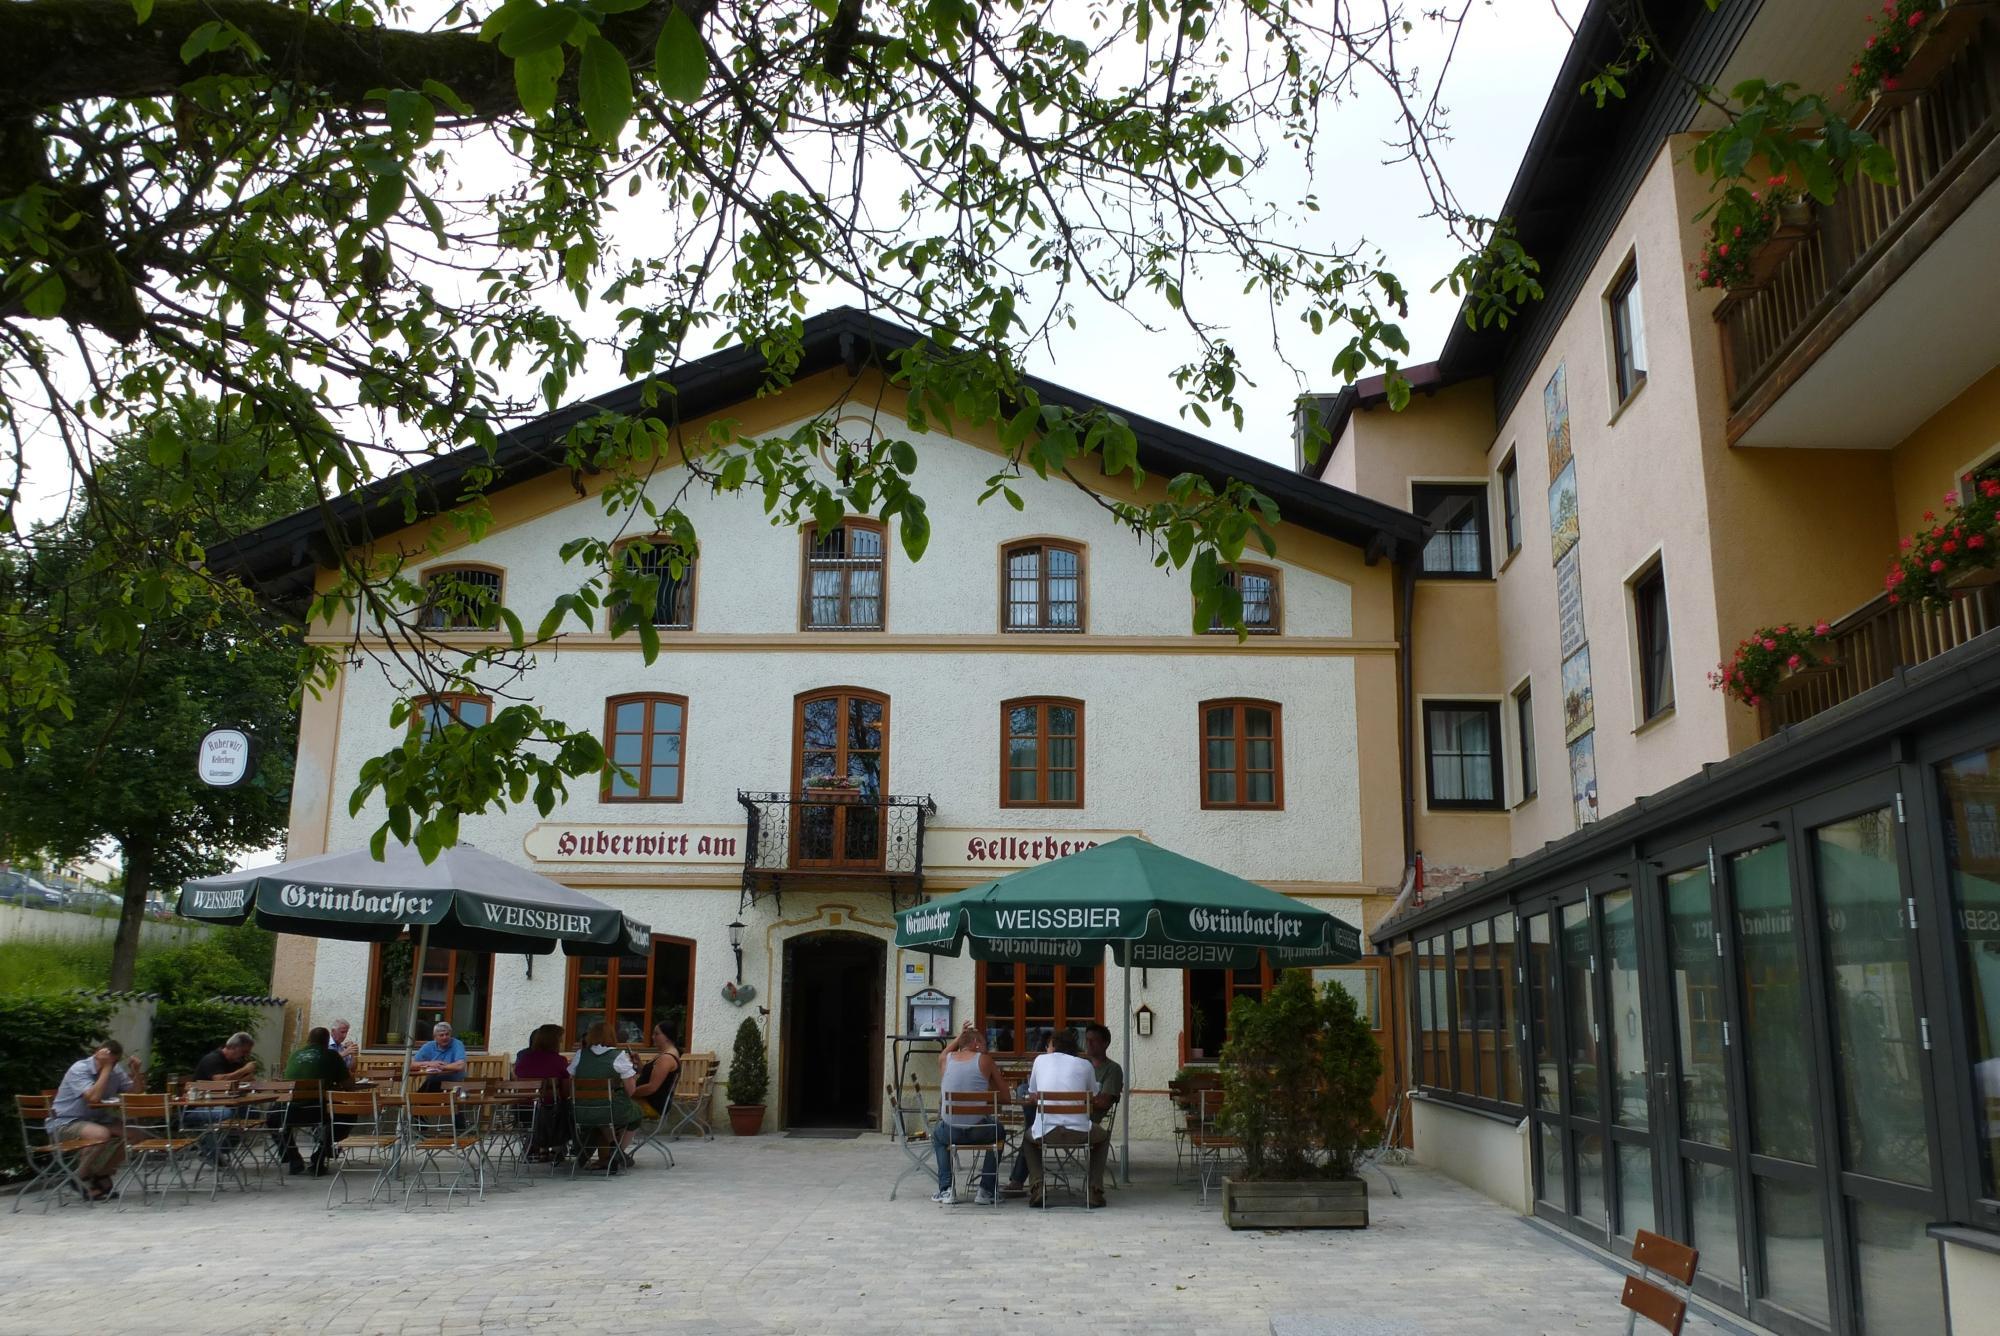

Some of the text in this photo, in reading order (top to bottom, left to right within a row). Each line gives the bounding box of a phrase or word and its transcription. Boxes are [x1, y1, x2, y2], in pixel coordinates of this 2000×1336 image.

[557, 830, 737, 857] Huberwirt am
[193, 889, 245, 910] WEISSBIER
[281, 884, 433, 920] Grünbacher
[482, 902, 592, 934] WEISSBIER
[905, 907, 950, 936] Grünbacher
[995, 908, 1120, 929] WEISSBIER
[1188, 907, 1302, 942] Grünbacher
